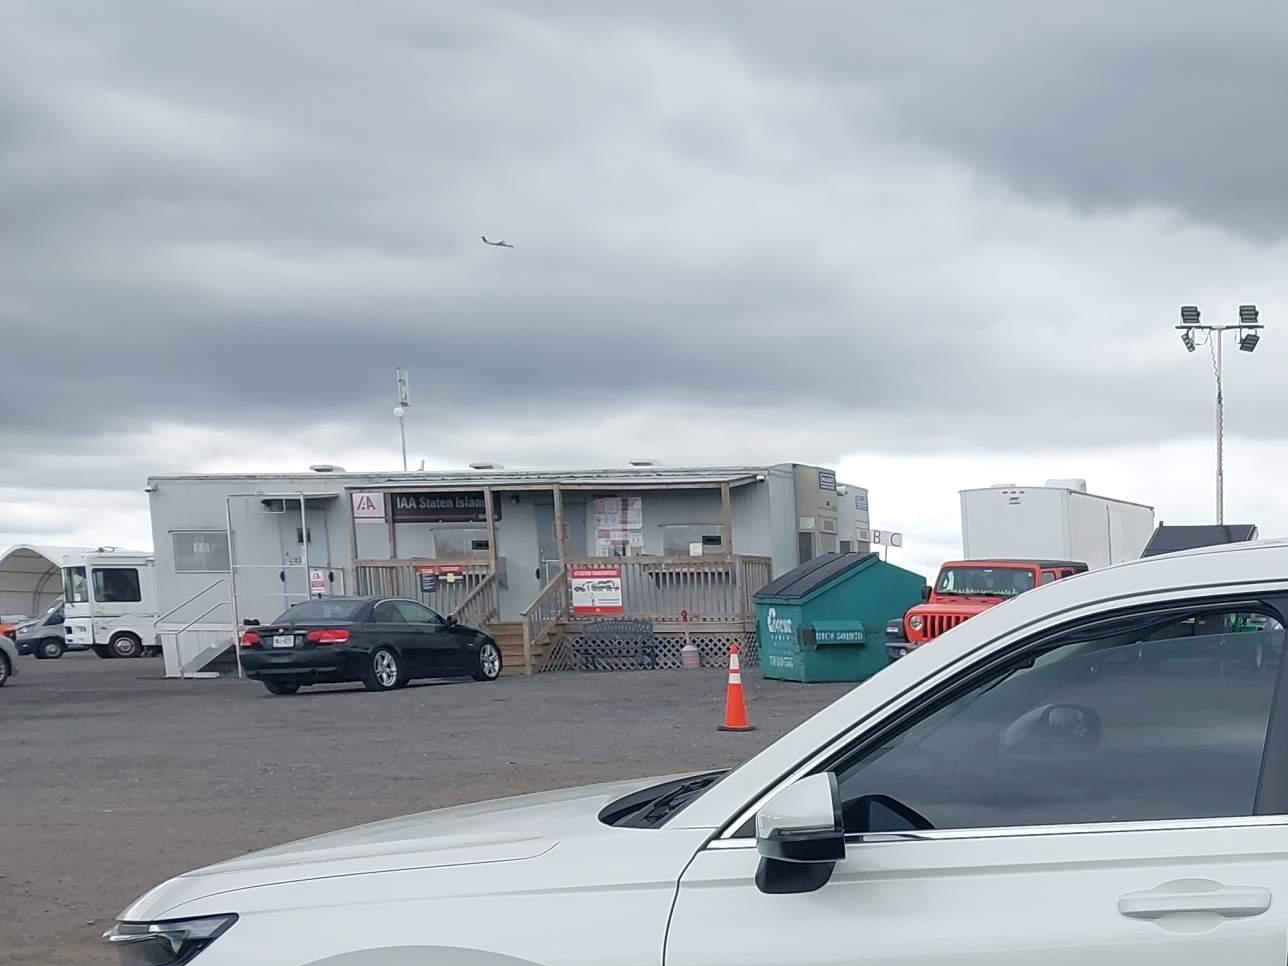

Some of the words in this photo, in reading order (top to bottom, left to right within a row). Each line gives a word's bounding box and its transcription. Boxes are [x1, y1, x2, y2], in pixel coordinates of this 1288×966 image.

[397, 496, 417, 509] IAA
[418, 496, 453, 509] Staten
[455, 496, 486, 508] Islan
[873, 530, 881, 544] B
[890, 532, 902, 547] C
